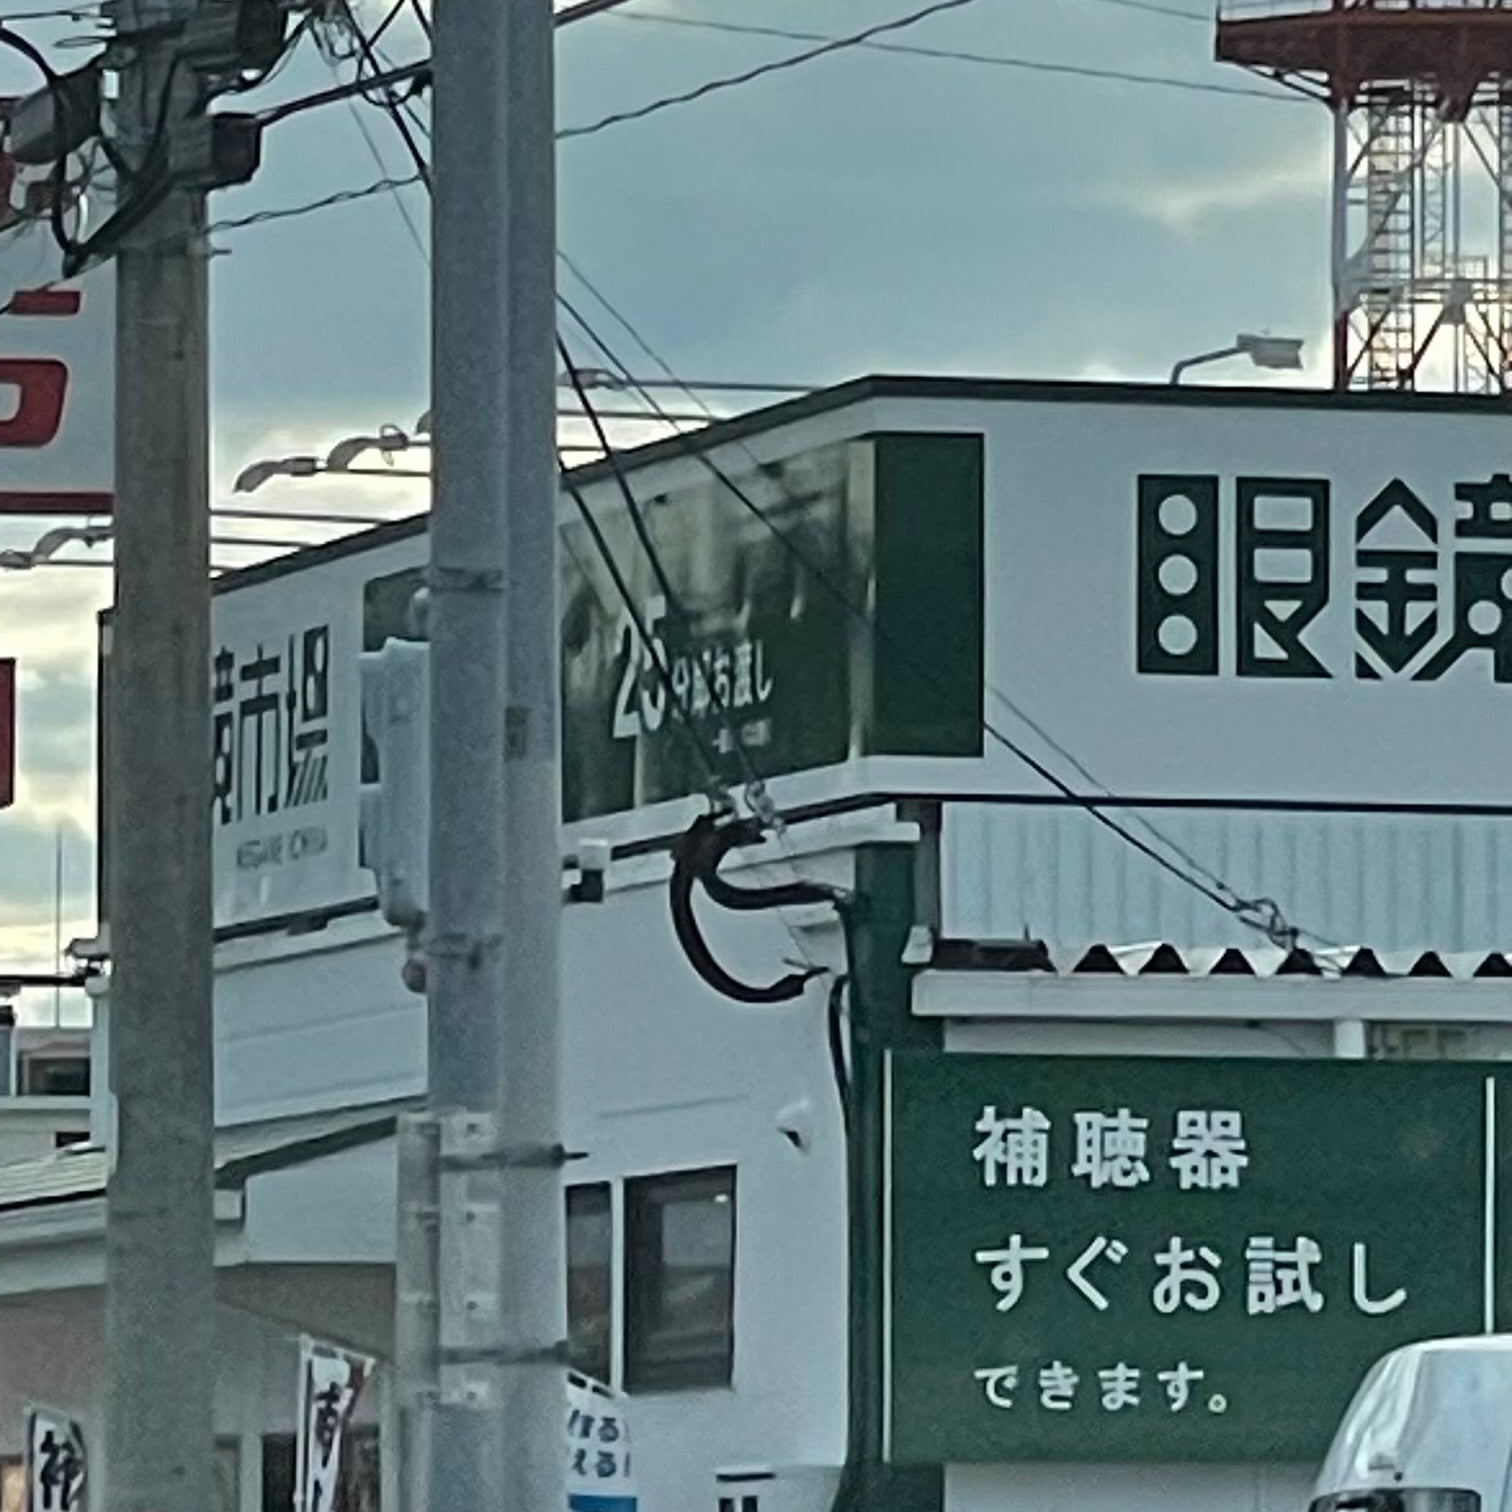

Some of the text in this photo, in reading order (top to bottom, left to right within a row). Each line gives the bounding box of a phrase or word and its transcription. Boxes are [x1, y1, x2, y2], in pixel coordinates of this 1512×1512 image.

[972, 1105, 1249, 1190] 補聴器
[974, 1233, 1408, 1316] すぐお試し
[973, 1359, 1228, 1414] できます。
